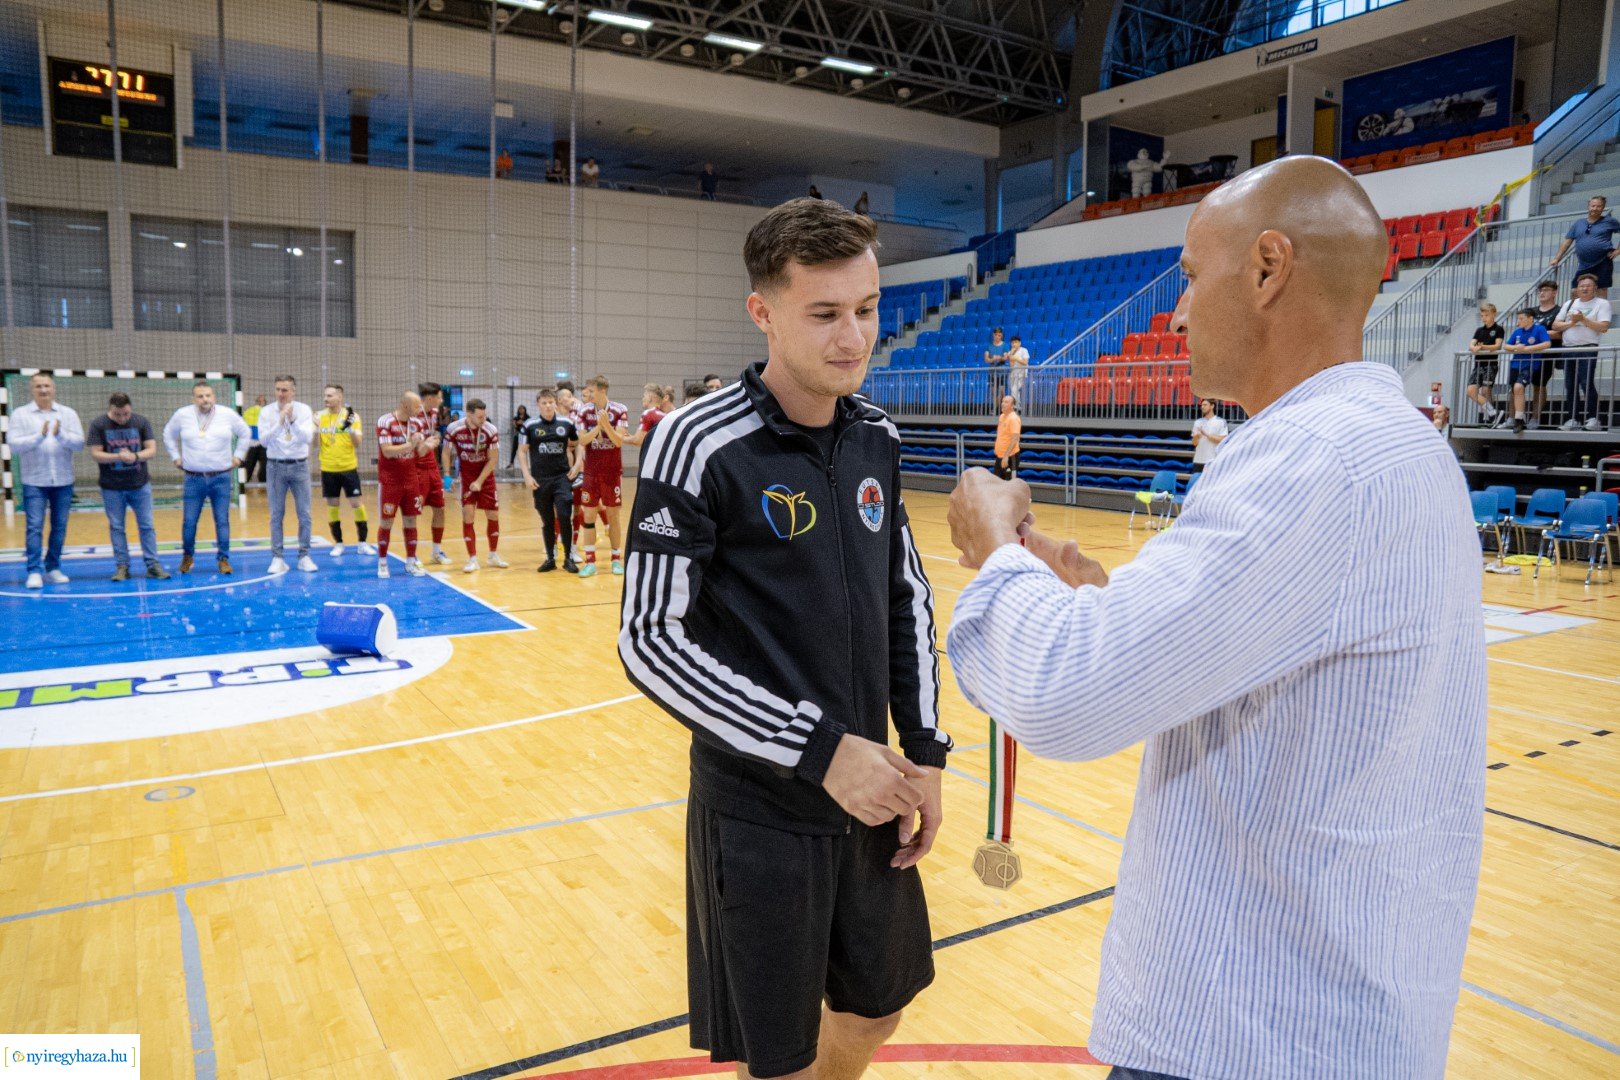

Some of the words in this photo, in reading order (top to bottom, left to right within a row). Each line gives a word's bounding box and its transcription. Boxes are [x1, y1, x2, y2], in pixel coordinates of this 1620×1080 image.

[1268, 39, 1317, 60] MICHELIN
[614, 486, 621, 497] 9
[638, 521, 680, 538] adidas
